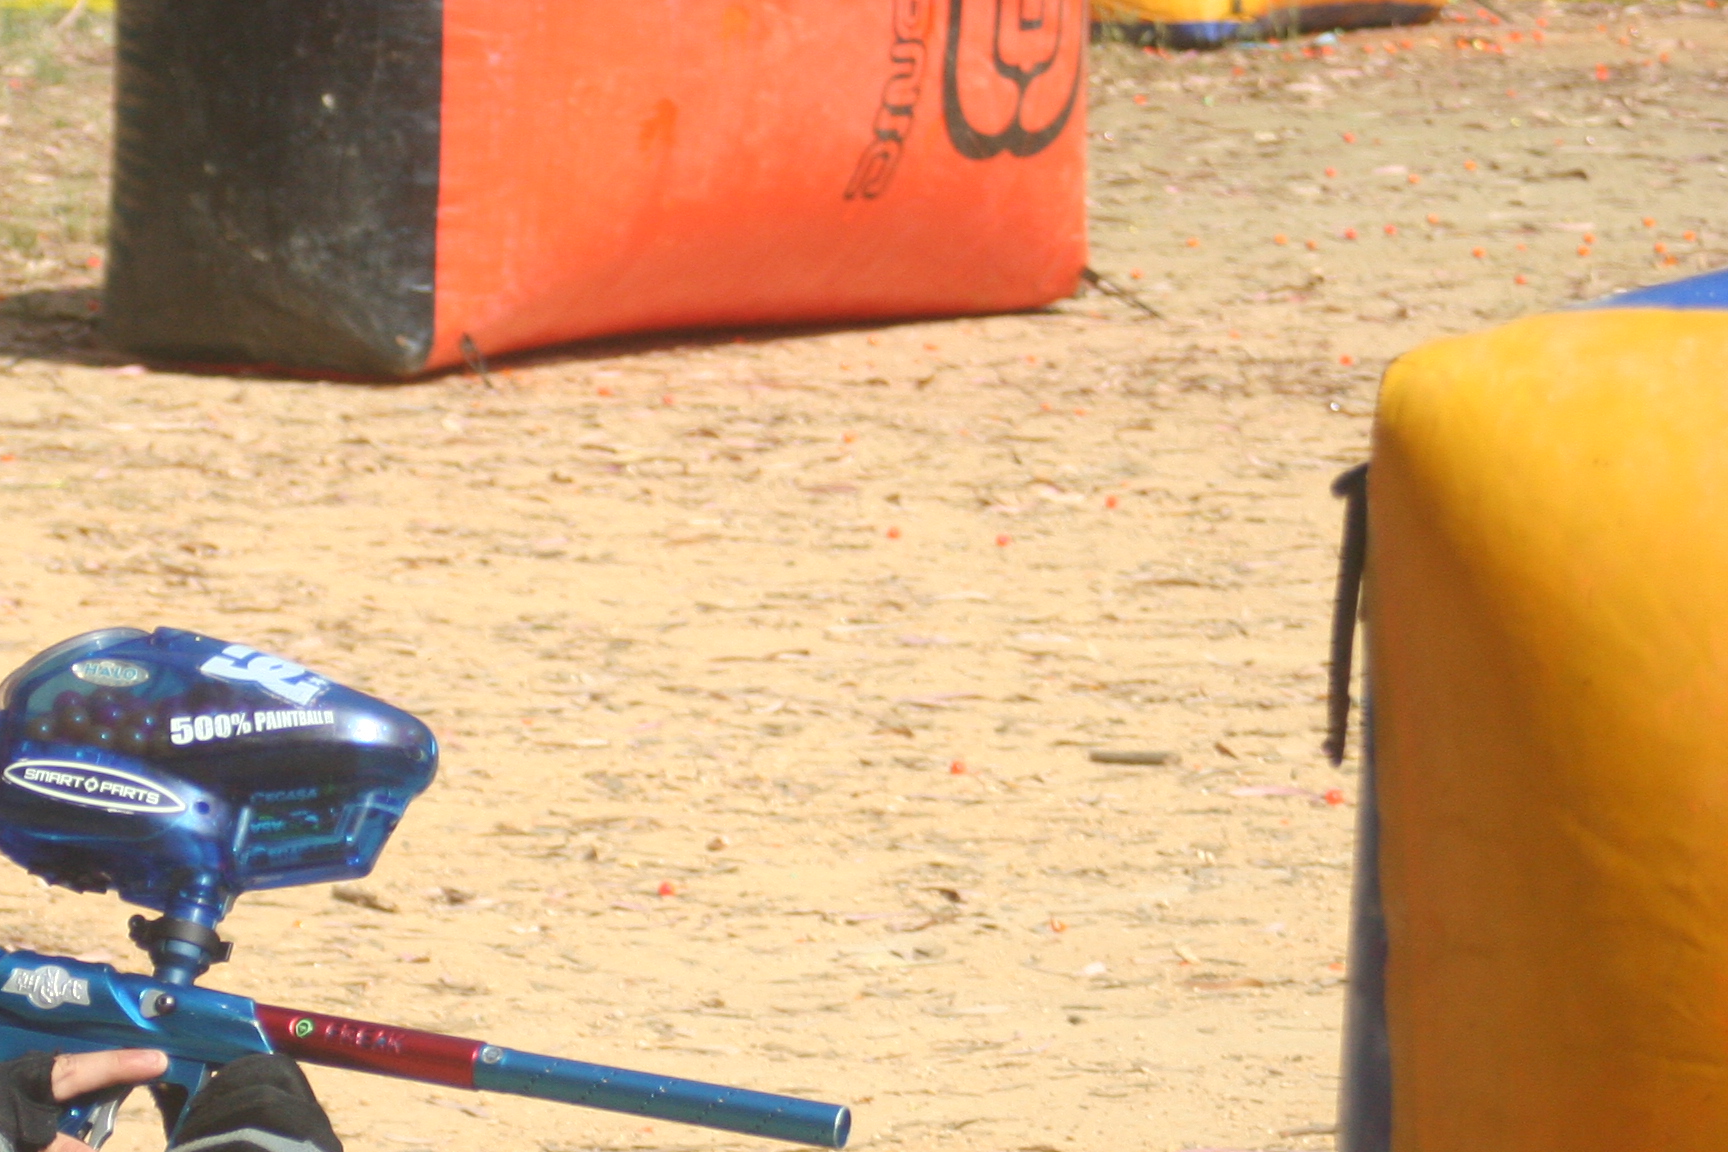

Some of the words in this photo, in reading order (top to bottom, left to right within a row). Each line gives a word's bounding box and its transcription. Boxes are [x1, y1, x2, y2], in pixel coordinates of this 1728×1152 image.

[84, 662, 138, 681] HALO
[170, 711, 252, 745] 500%
[254, 710, 324, 732] PAINTBALL
[24, 767, 84, 788] SMART
[100, 781, 160, 805] PARTS
